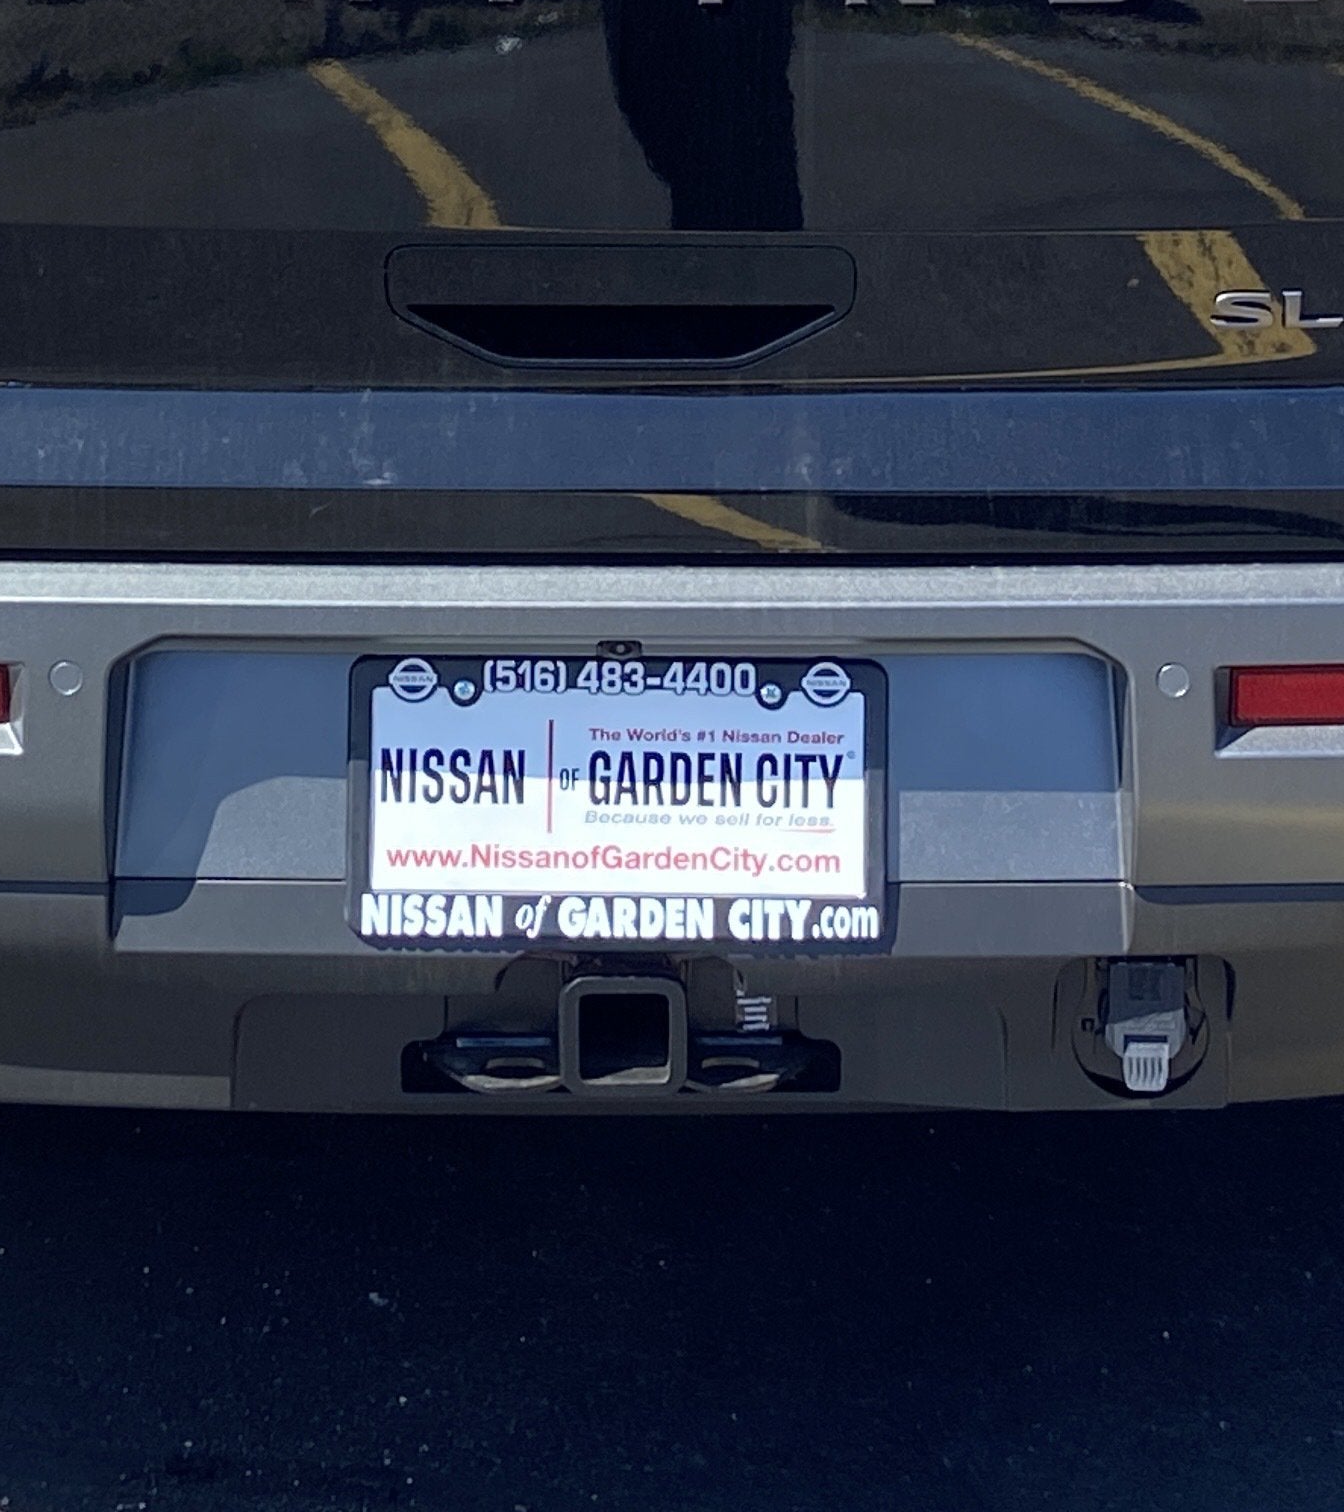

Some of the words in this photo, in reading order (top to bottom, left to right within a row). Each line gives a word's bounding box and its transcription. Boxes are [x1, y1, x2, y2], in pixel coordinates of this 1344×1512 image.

[1209, 290, 1344, 329] SL
[483, 659, 568, 694] (516)
[576, 660, 757, 696] 483-4400
[589, 727, 622, 742] The
[626, 728, 691, 743] World's
[697, 729, 716, 743] #1
[722, 729, 782, 744] Nissan
[787, 730, 845, 745] Dealer
[380, 747, 526, 805] NISSAN
[559, 767, 580, 791] OF
[588, 749, 743, 808] GARDEN
[756, 752, 844, 809] CITY
[584, 810, 672, 826] Because
[678, 813, 708, 826] we
[715, 812, 750, 827] sell
[755, 813, 783, 827] for
[386, 843, 841, 878] www.NissanofGardenCity.com
[360, 892, 503, 937] NISSAN
[514, 894, 552, 939] of
[557, 895, 714, 939] GARDEN
[727, 897, 880, 941] CITY.com
